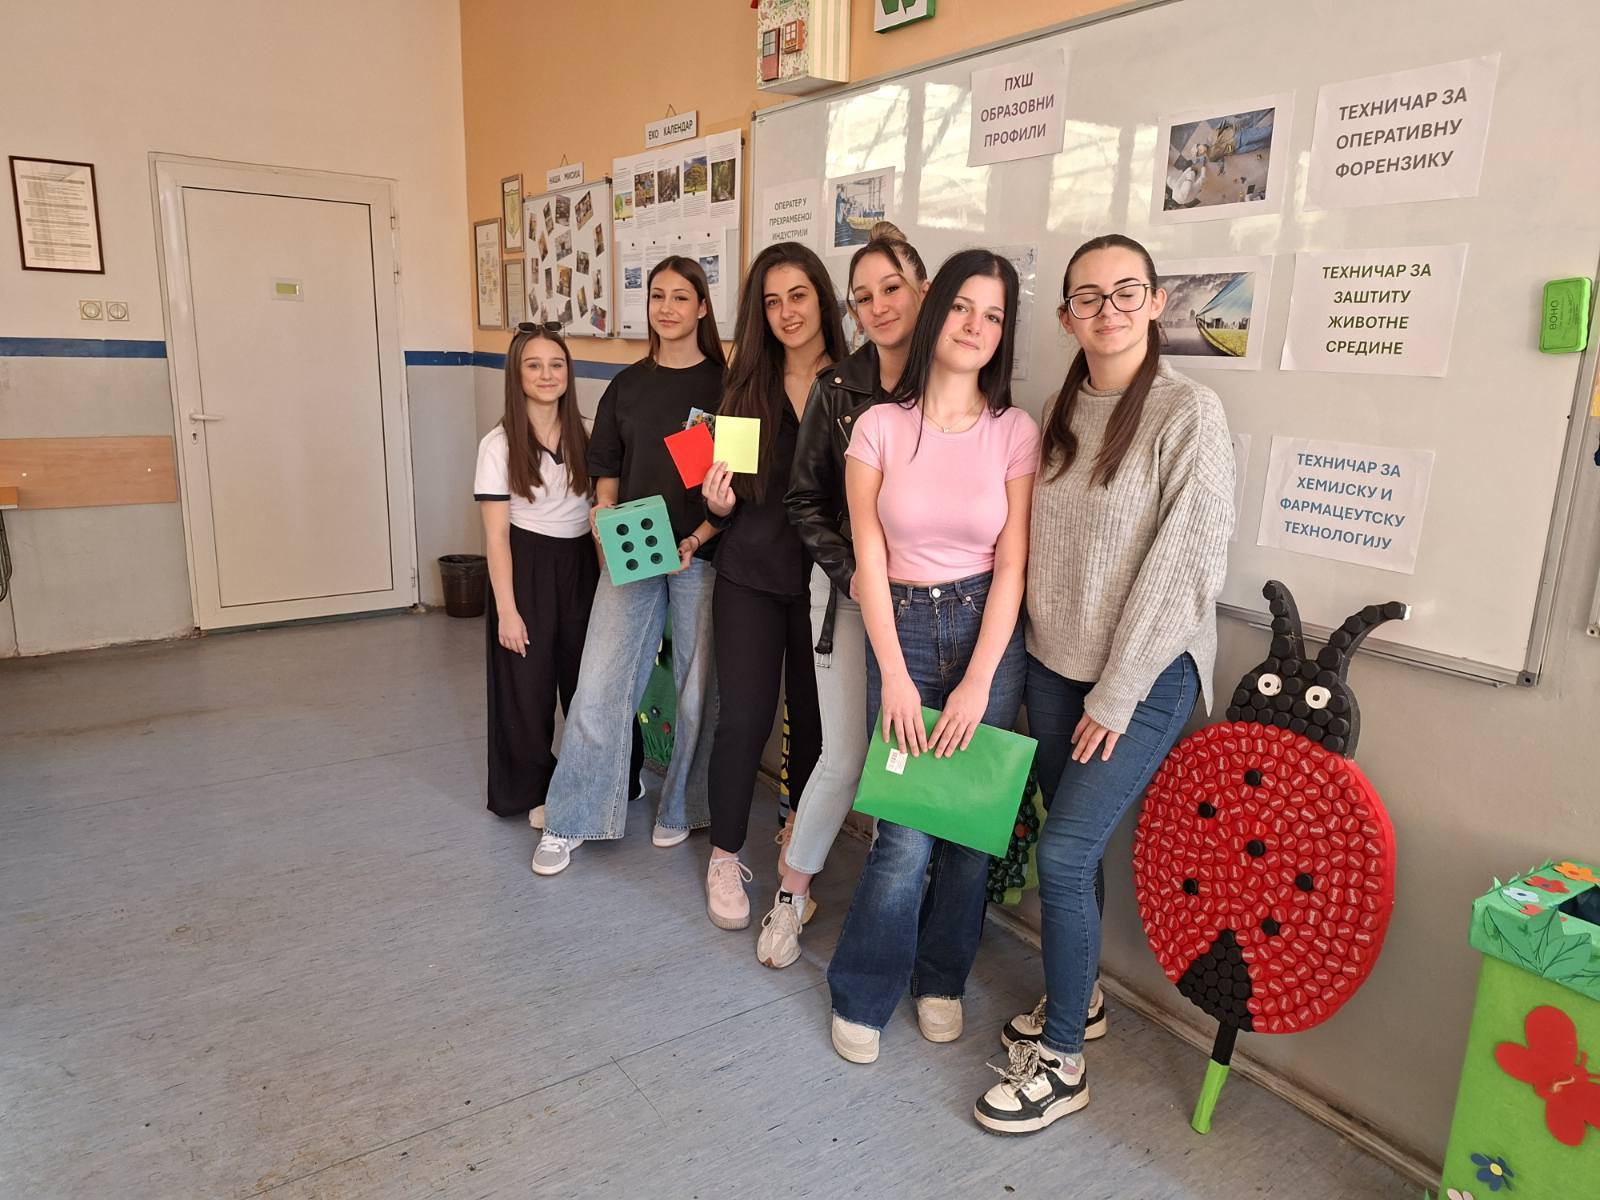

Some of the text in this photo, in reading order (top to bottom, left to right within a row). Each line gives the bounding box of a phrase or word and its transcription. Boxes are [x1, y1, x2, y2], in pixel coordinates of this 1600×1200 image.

[1004, 72, 1033, 91] ПХШ
[981, 94, 1054, 122] ОБРАЗОВНИ
[1339, 86, 1467, 121] ТЕХНИЧАР ЗА
[663, 119, 693, 137] КАЛЕНДАР
[984, 123, 1046, 147] ПРОФИЛИ
[1336, 118, 1463, 149] ОПЕРАТИВНУ
[1335, 150, 1454, 178] ФОРЕНЗИКУ
[774, 198, 802, 211] ОПЕРАТЕР
[1322, 263, 1432, 279] ТЕХНИЧАР ЗА
[1333, 290, 1411, 304] ЗАШТИТУ
[1327, 315, 1409, 329] ЖИВОТНЕ
[1325, 340, 1404, 356] СРЕДИНЕ
[1297, 453, 1401, 478] ТЕХНИЧАР ЗА
[1296, 476, 1393, 501] ХЕМИЈСКУ И
[1280, 497, 1406, 527] ФАРМАЦЕУТСКУ
[1284, 520, 1392, 550] ТЕХНОЛОГИЈУ
